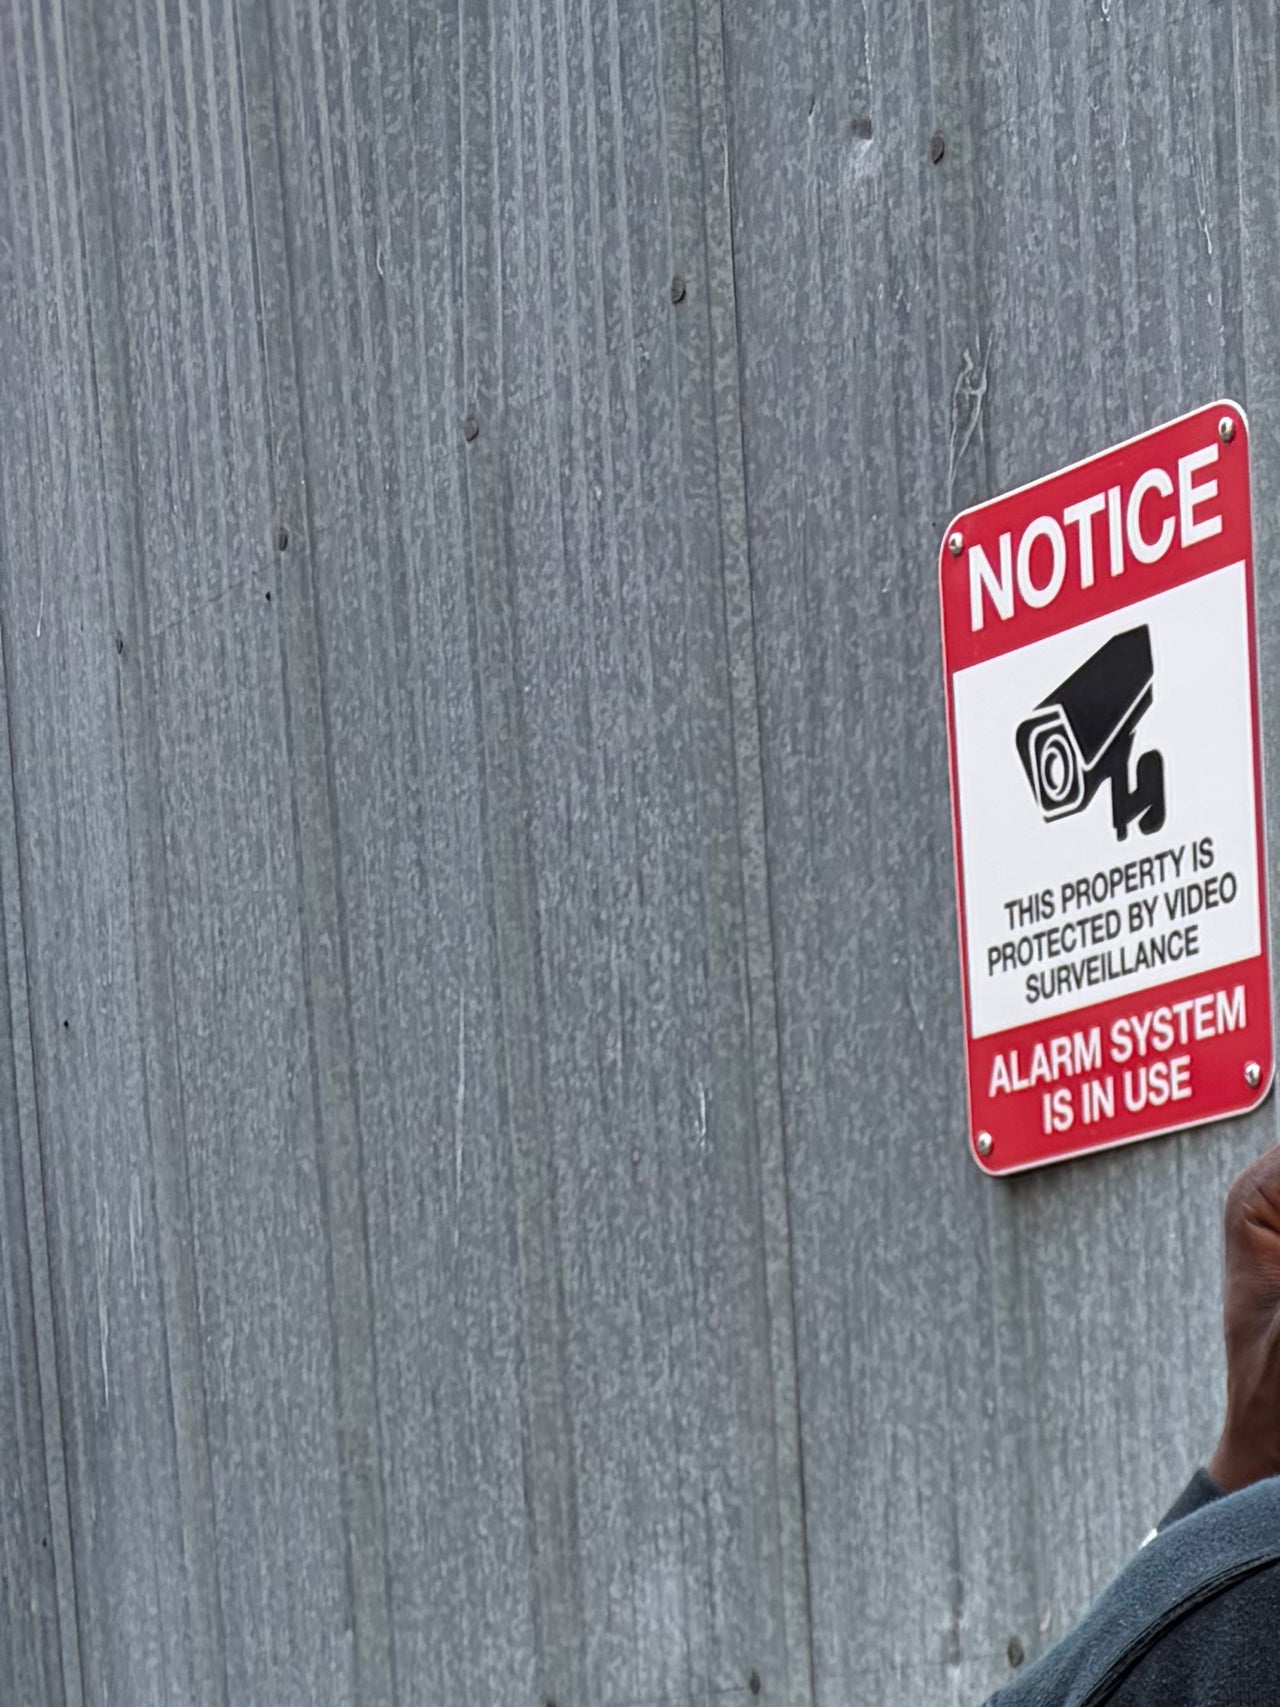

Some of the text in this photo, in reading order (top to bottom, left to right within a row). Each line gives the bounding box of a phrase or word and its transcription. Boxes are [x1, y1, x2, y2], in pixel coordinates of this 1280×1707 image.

[968, 443, 1222, 631] NOTICE
[988, 872, 1237, 976] PROTECTED BY VIDEO
[1004, 837, 1214, 930] THIS PROPERTY IS
[1026, 925, 1199, 1003] SURVEILLANCE
[988, 985, 1246, 1098] ALARM SYSTEM
[1043, 1055, 1192, 1134] IS IN USE
